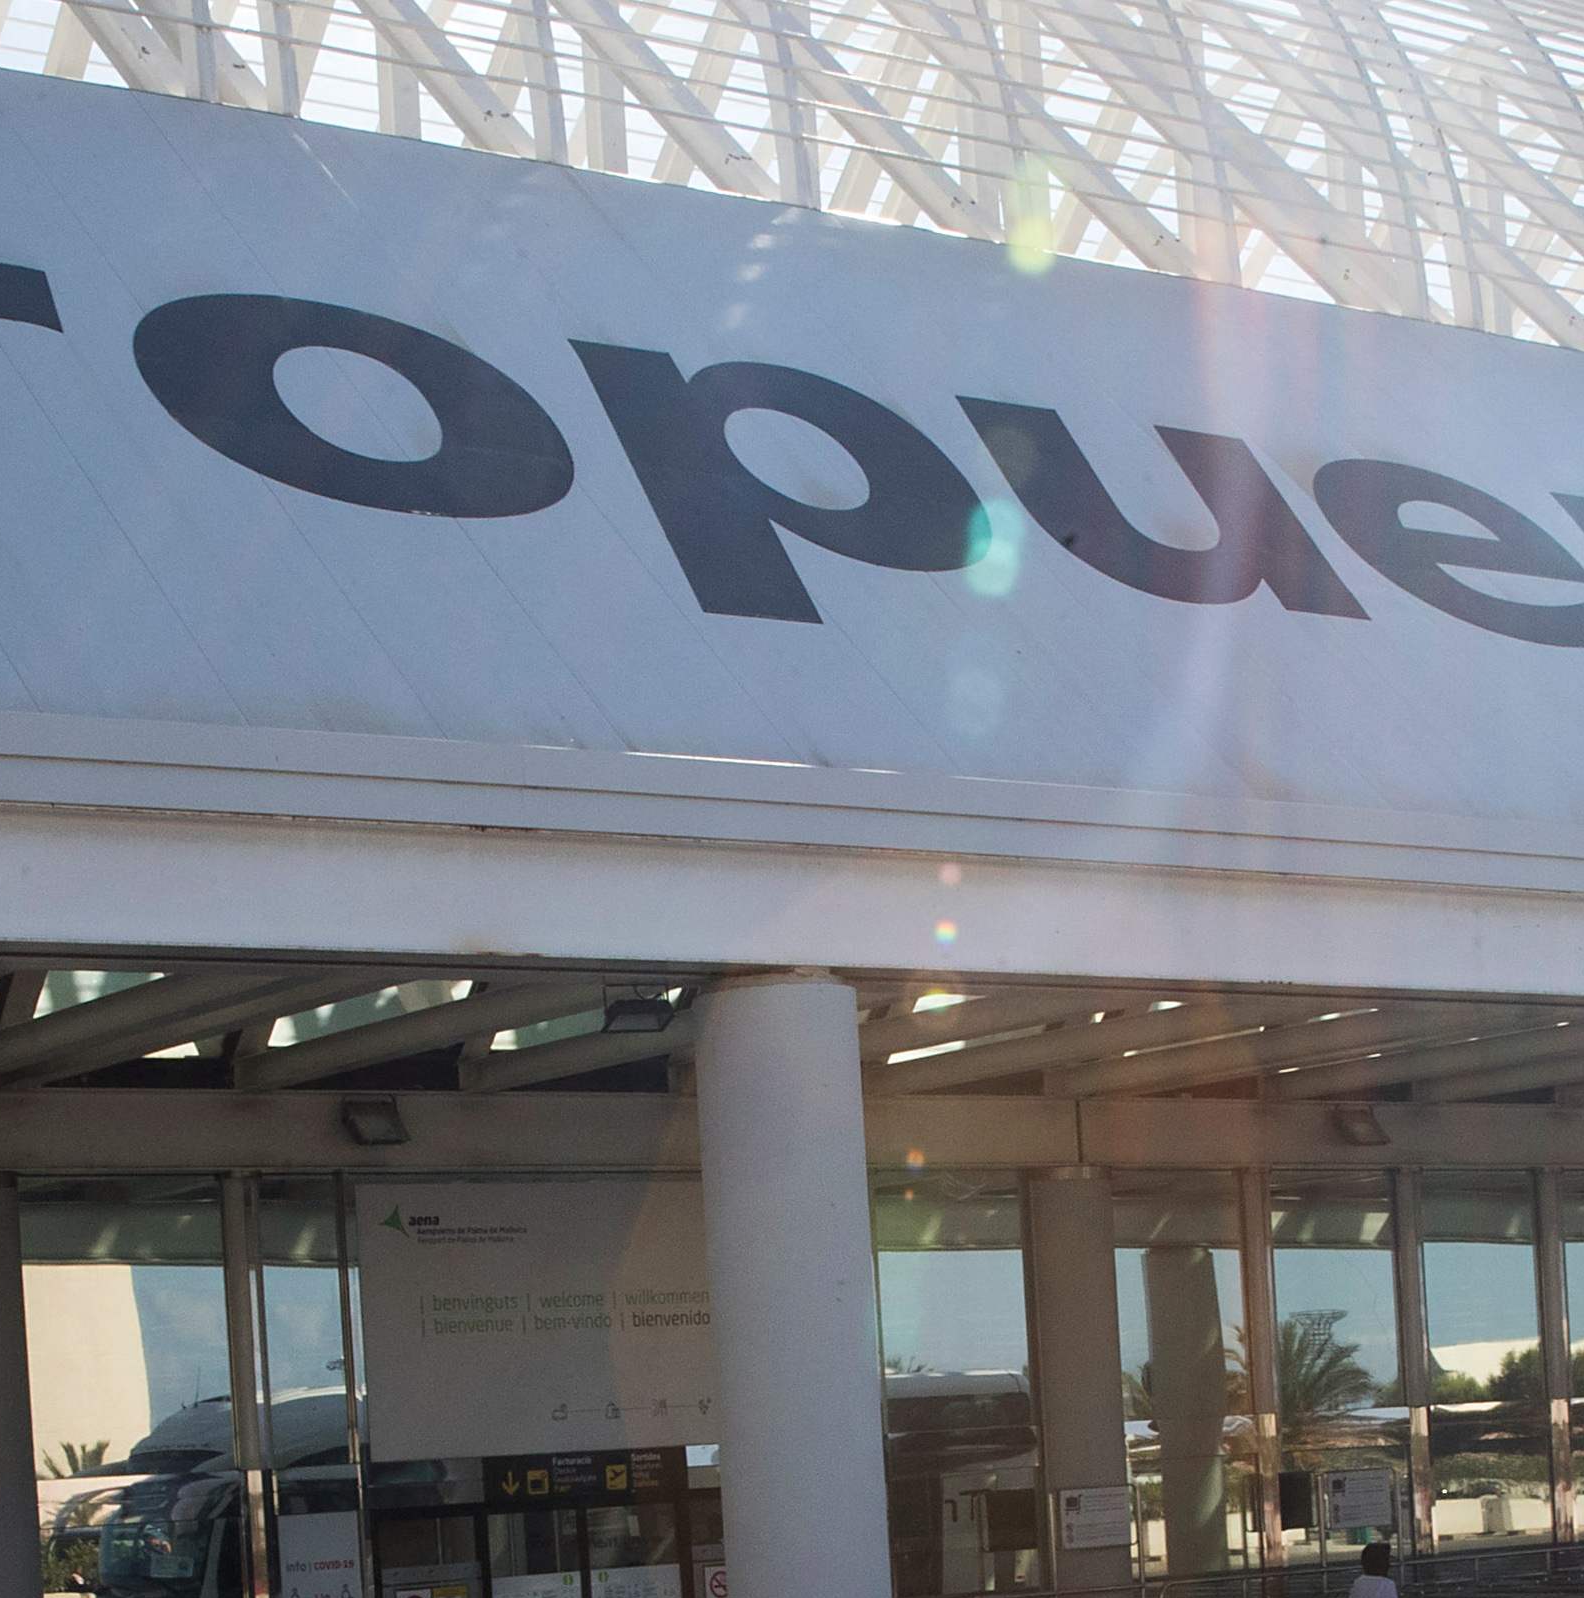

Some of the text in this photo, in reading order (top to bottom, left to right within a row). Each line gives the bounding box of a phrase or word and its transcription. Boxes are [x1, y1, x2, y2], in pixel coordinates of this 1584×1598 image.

[409, 1216, 439, 1226] aena
[432, 1289, 710, 1313] benvinguts welcome willkommen
[433, 1309, 710, 1334] bienvenue bem-vindo bienvenido
